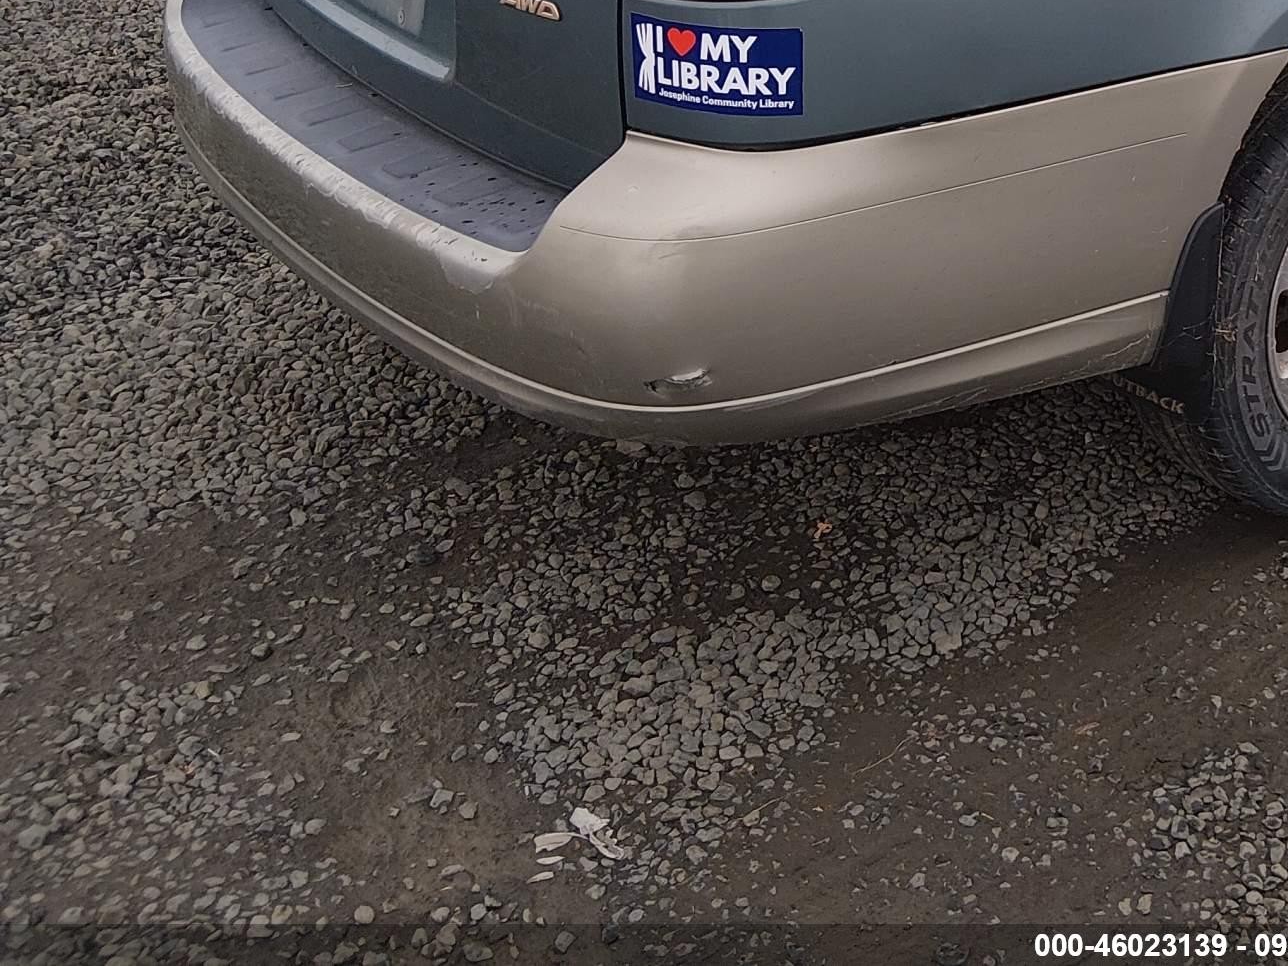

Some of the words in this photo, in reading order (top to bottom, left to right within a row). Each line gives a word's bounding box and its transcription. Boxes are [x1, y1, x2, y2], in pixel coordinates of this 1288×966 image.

[656, 25, 664, 53] I
[700, 33, 758, 64] MY
[657, 56, 796, 96] LIBRARY
[659, 87, 701, 104] Josephine
[702, 95, 758, 110] Community
[759, 98, 795, 110] Library
